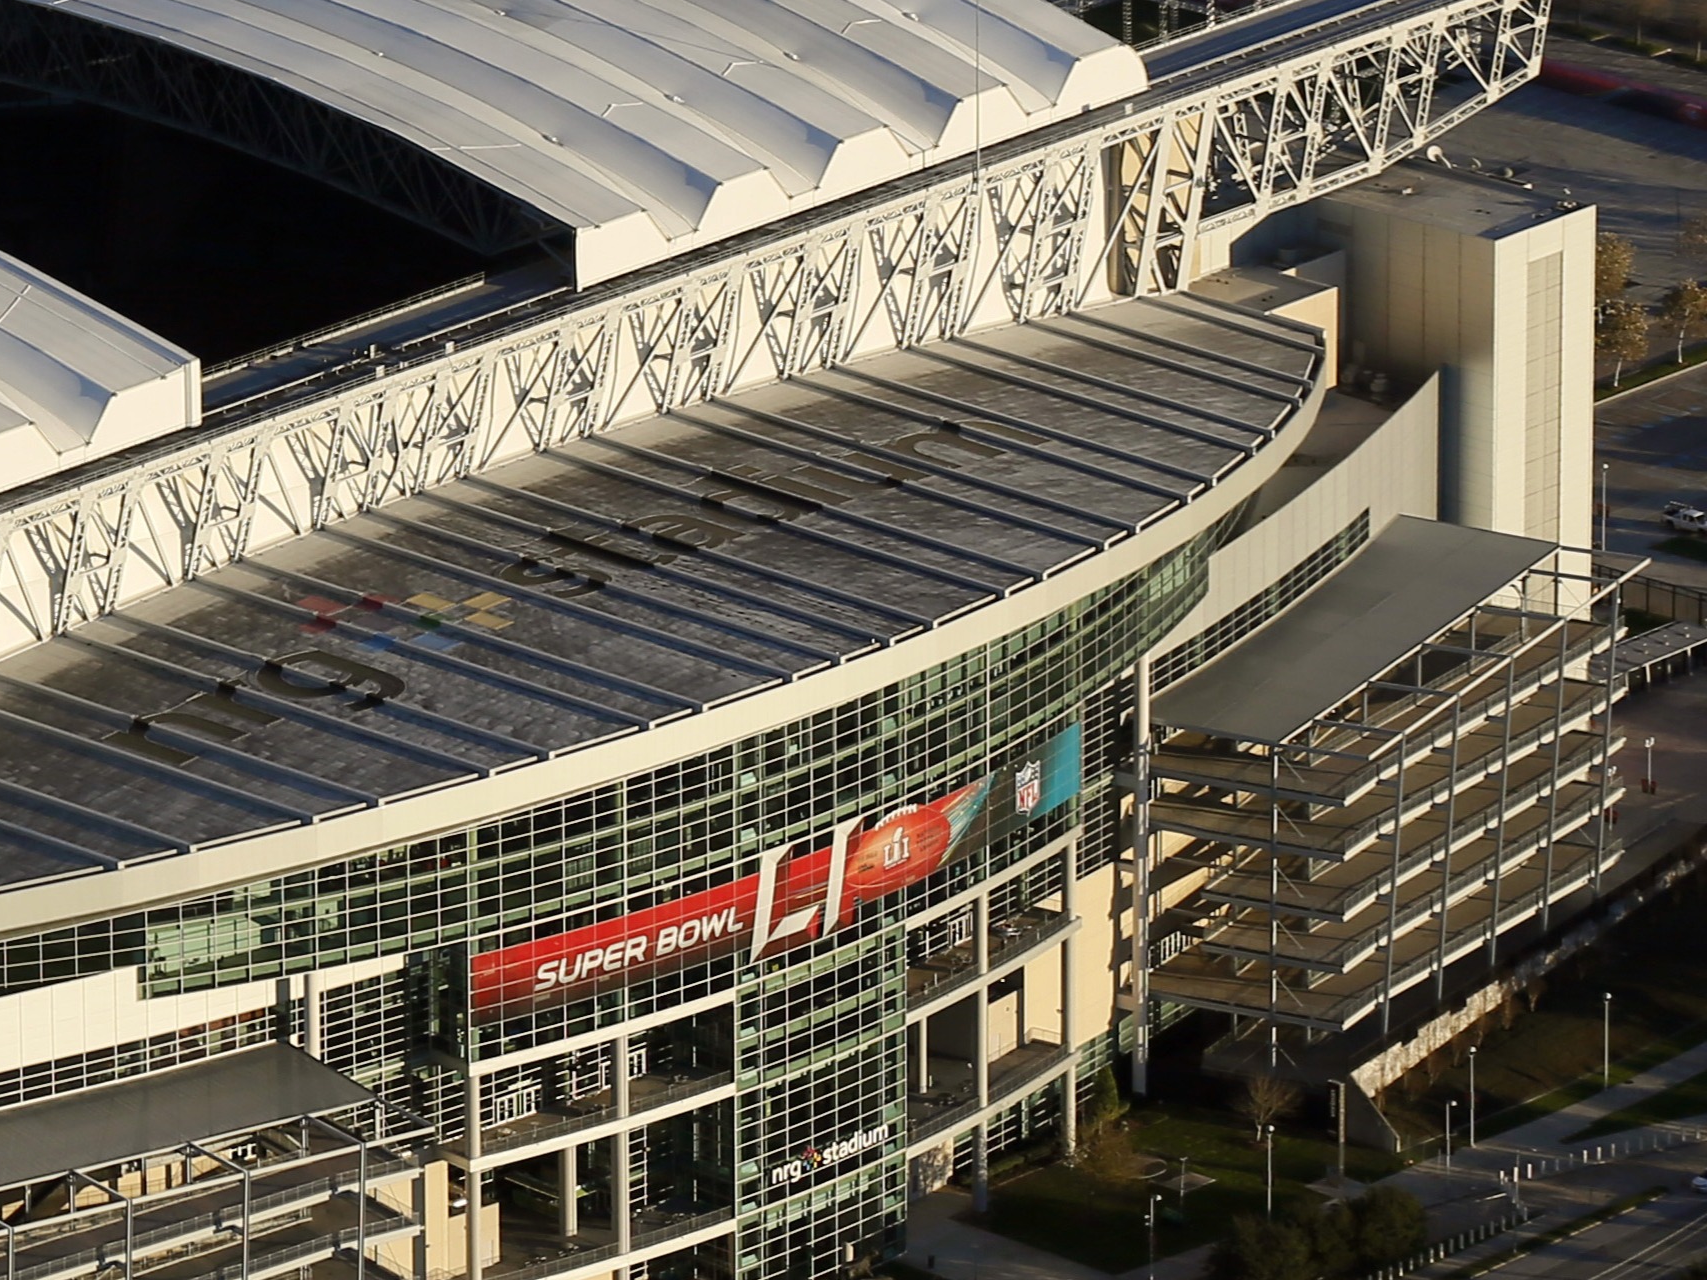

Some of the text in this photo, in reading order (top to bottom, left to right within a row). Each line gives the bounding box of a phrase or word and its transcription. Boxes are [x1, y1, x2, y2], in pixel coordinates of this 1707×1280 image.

[101, 648, 408, 767] nrg
[532, 905, 745, 995] SUPER BOWL
[770, 1121, 890, 1186] nrg stadium
